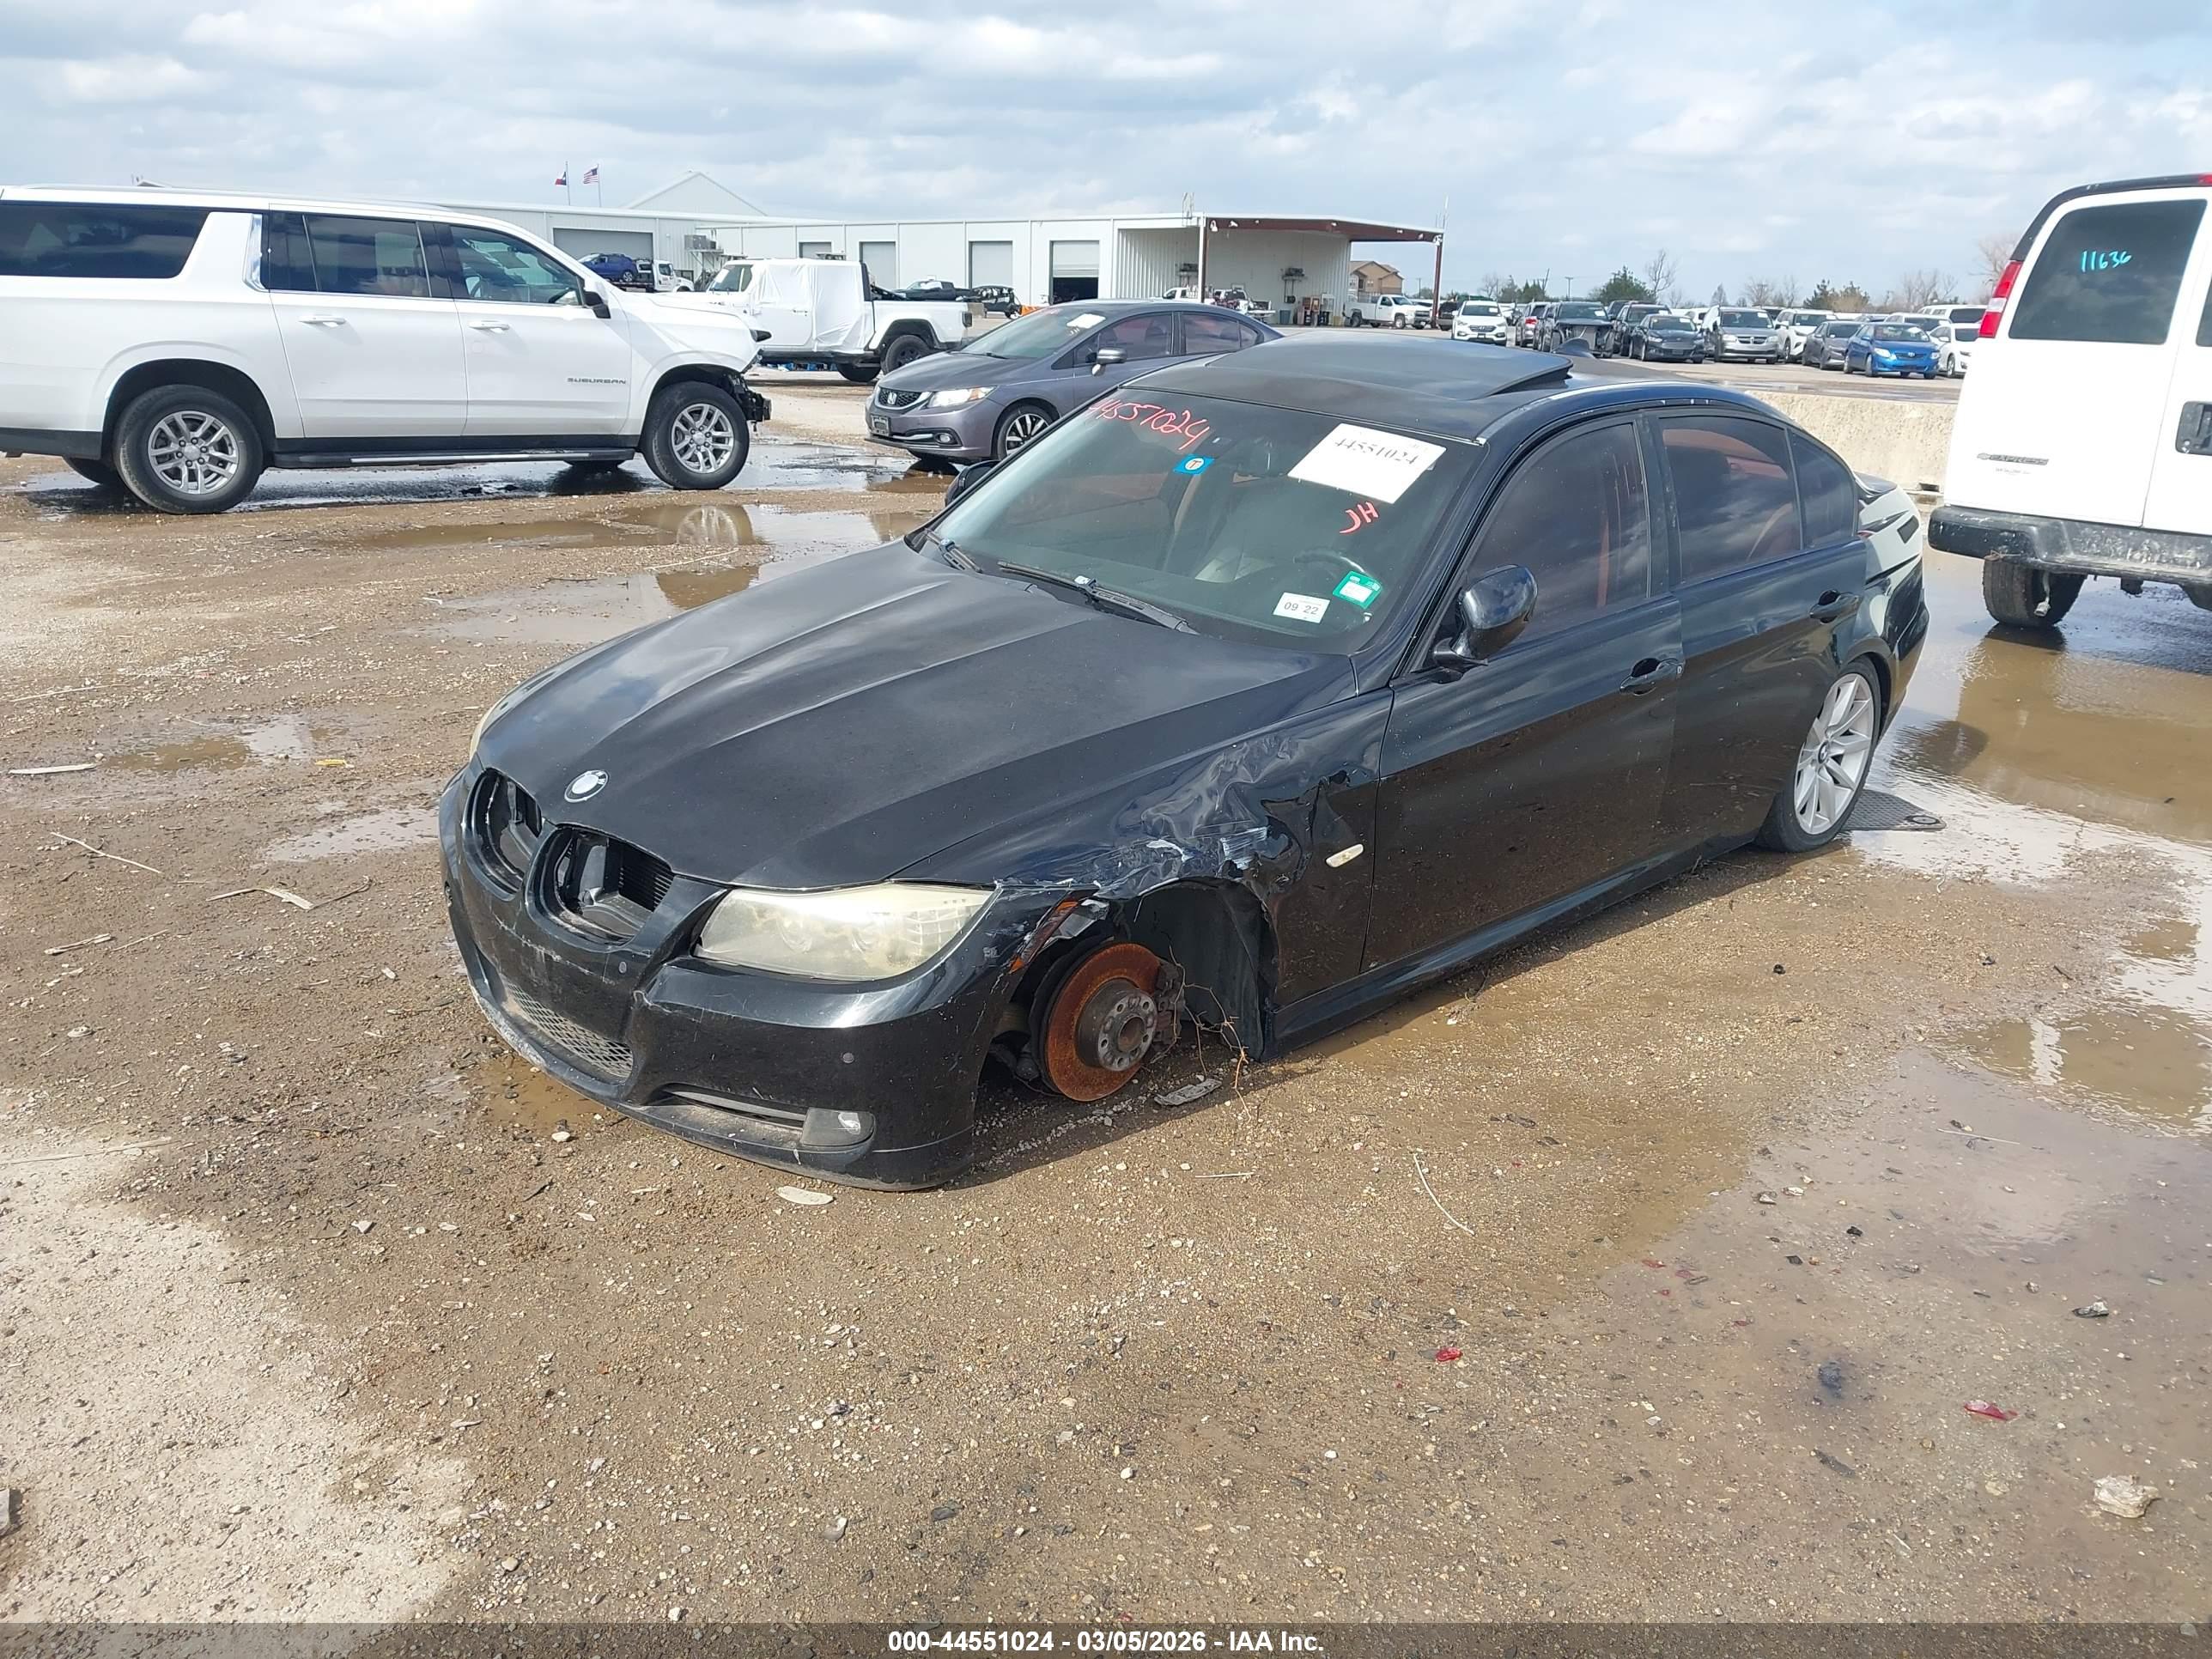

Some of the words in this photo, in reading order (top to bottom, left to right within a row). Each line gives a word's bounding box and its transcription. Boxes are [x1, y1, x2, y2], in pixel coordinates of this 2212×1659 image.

[2081, 250, 2132, 273] 11636
[1334, 438, 1419, 465] 44551024
[1339, 501, 1380, 534] JH
[1284, 601, 1298, 611] 09
[1303, 605, 1320, 616] 22
